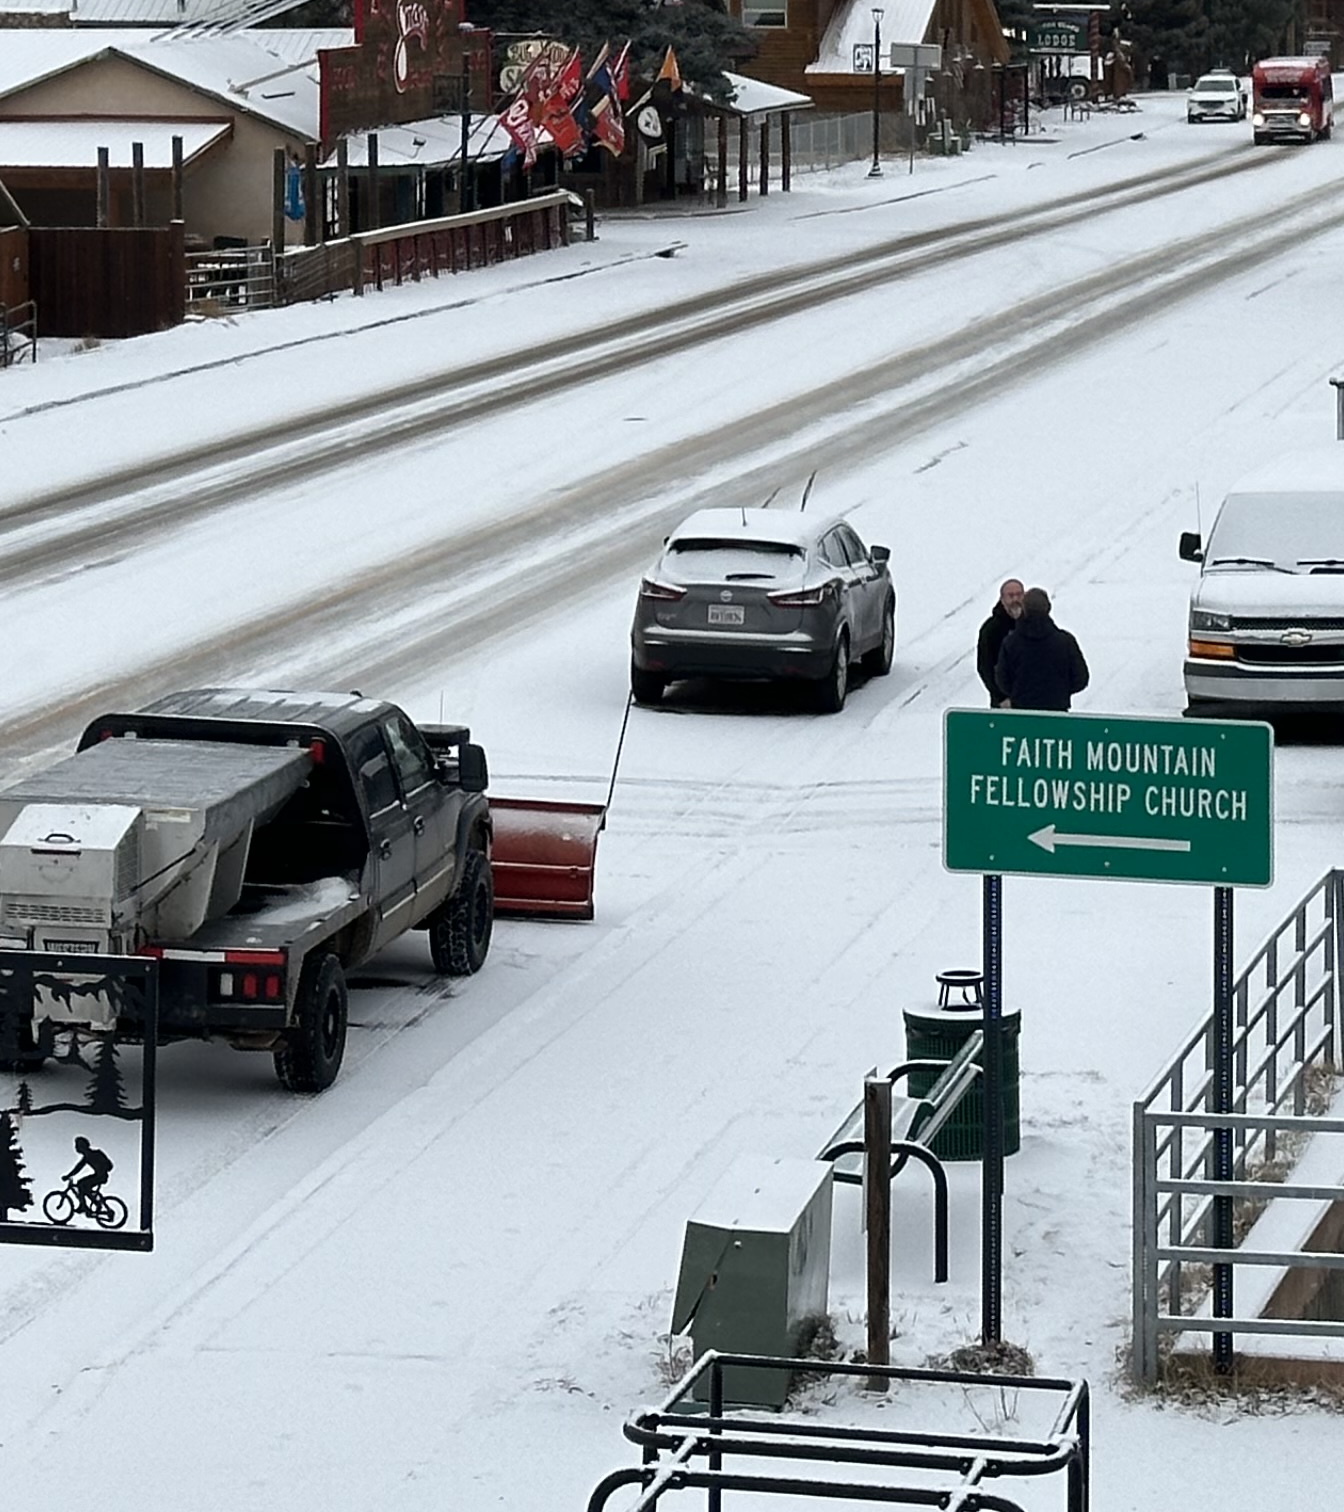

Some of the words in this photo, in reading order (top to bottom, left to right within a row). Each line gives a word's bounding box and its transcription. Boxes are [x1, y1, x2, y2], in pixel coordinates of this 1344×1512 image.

[1037, 34, 1076, 46] LODGE
[1002, 736, 1073, 771] FAITH
[1087, 740, 1217, 778] MOUNTAIN
[970, 774, 1132, 814] FELLOWSHIP
[1144, 785, 1249, 821] CHURCH
